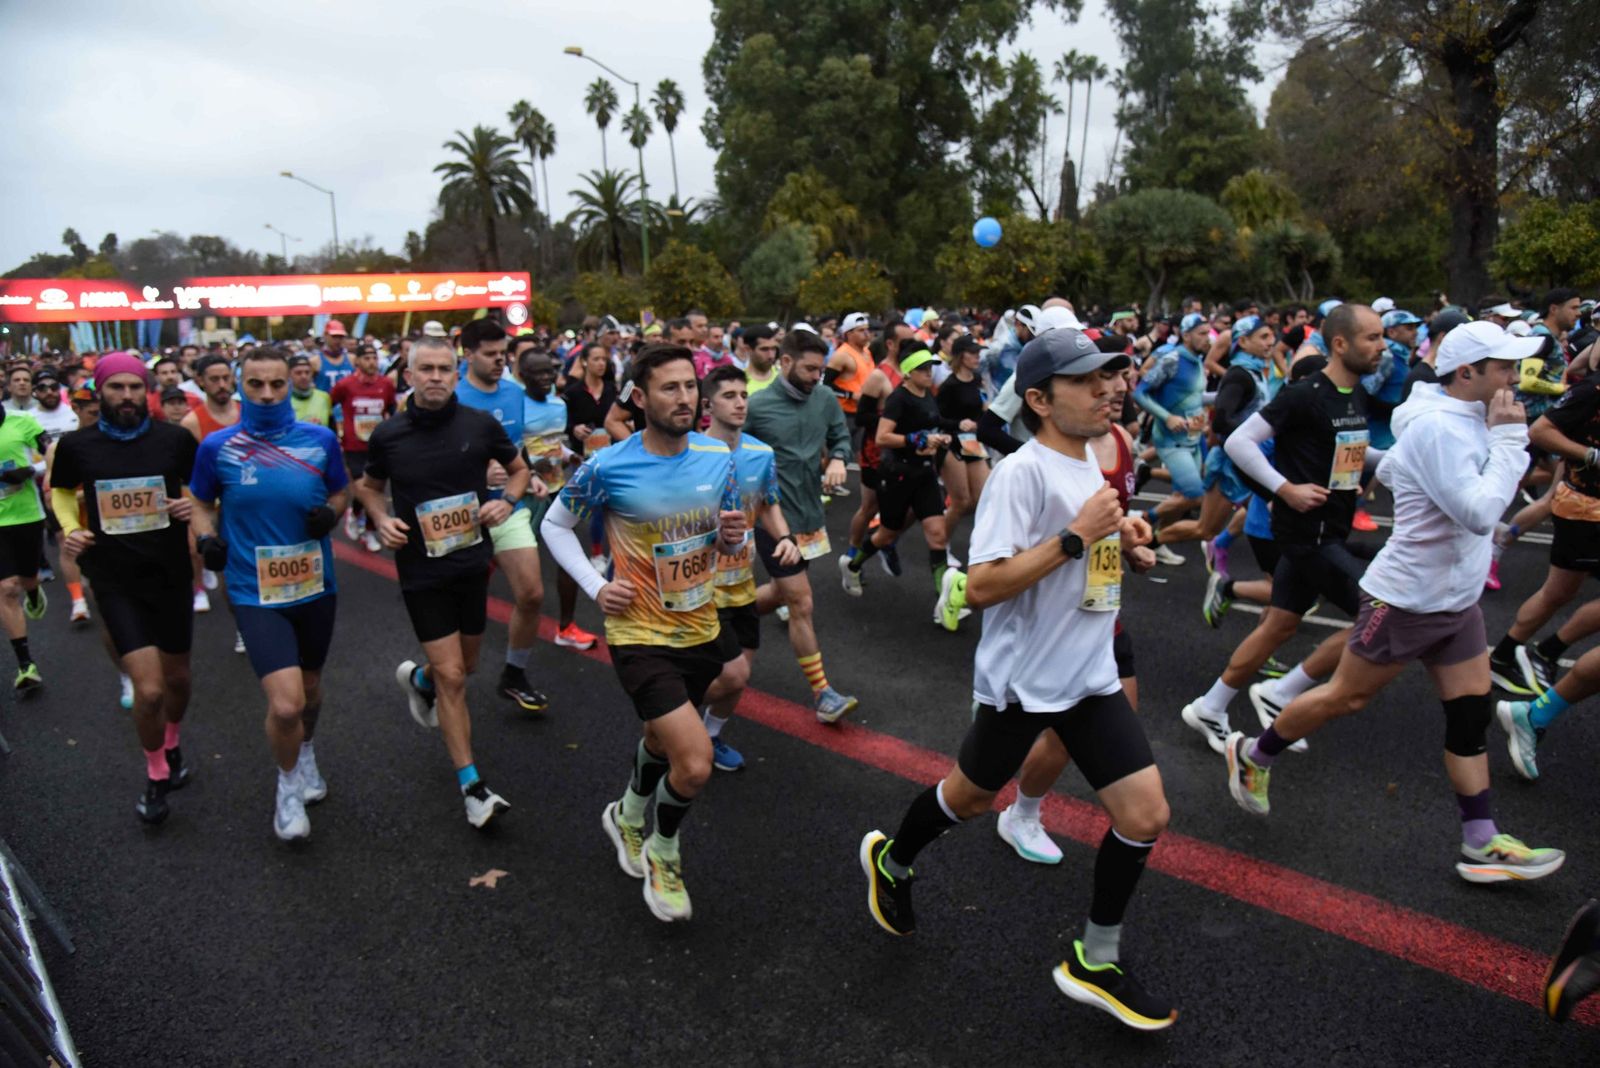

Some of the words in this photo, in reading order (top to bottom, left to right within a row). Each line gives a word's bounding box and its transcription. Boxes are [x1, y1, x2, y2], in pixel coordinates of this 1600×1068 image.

[111, 491, 153, 510] 8057
[431, 508, 470, 531] 8200
[268, 557, 310, 578] 6005
[668, 552, 708, 581] 7668
